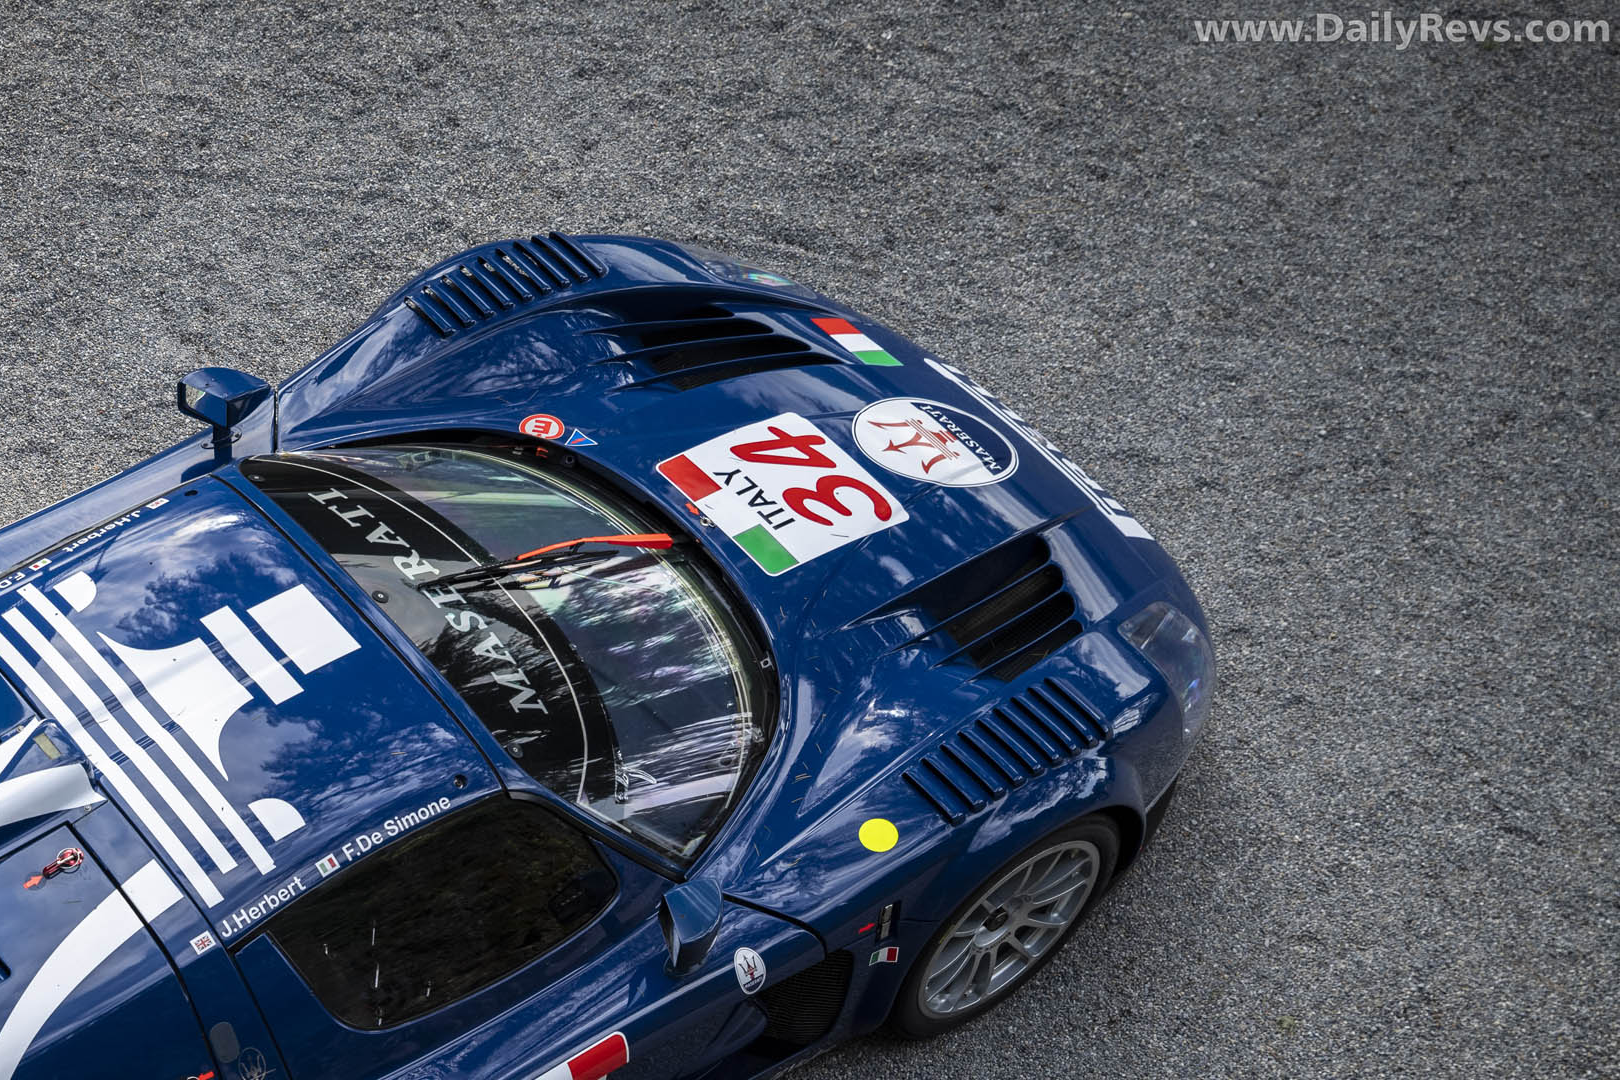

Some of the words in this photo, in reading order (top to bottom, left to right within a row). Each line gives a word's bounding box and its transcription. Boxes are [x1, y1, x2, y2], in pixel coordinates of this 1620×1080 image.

[920, 404, 1002, 472] MASERATI
[712, 468, 796, 531] ITALY
[730, 426, 892, 527] 34
[62, 510, 141, 553] J.Herbert
[307, 488, 549, 715] MASERATI
[341, 830, 384, 862] F.De
[383, 796, 452, 838] Simone
[221, 876, 307, 939] J.Herbert
